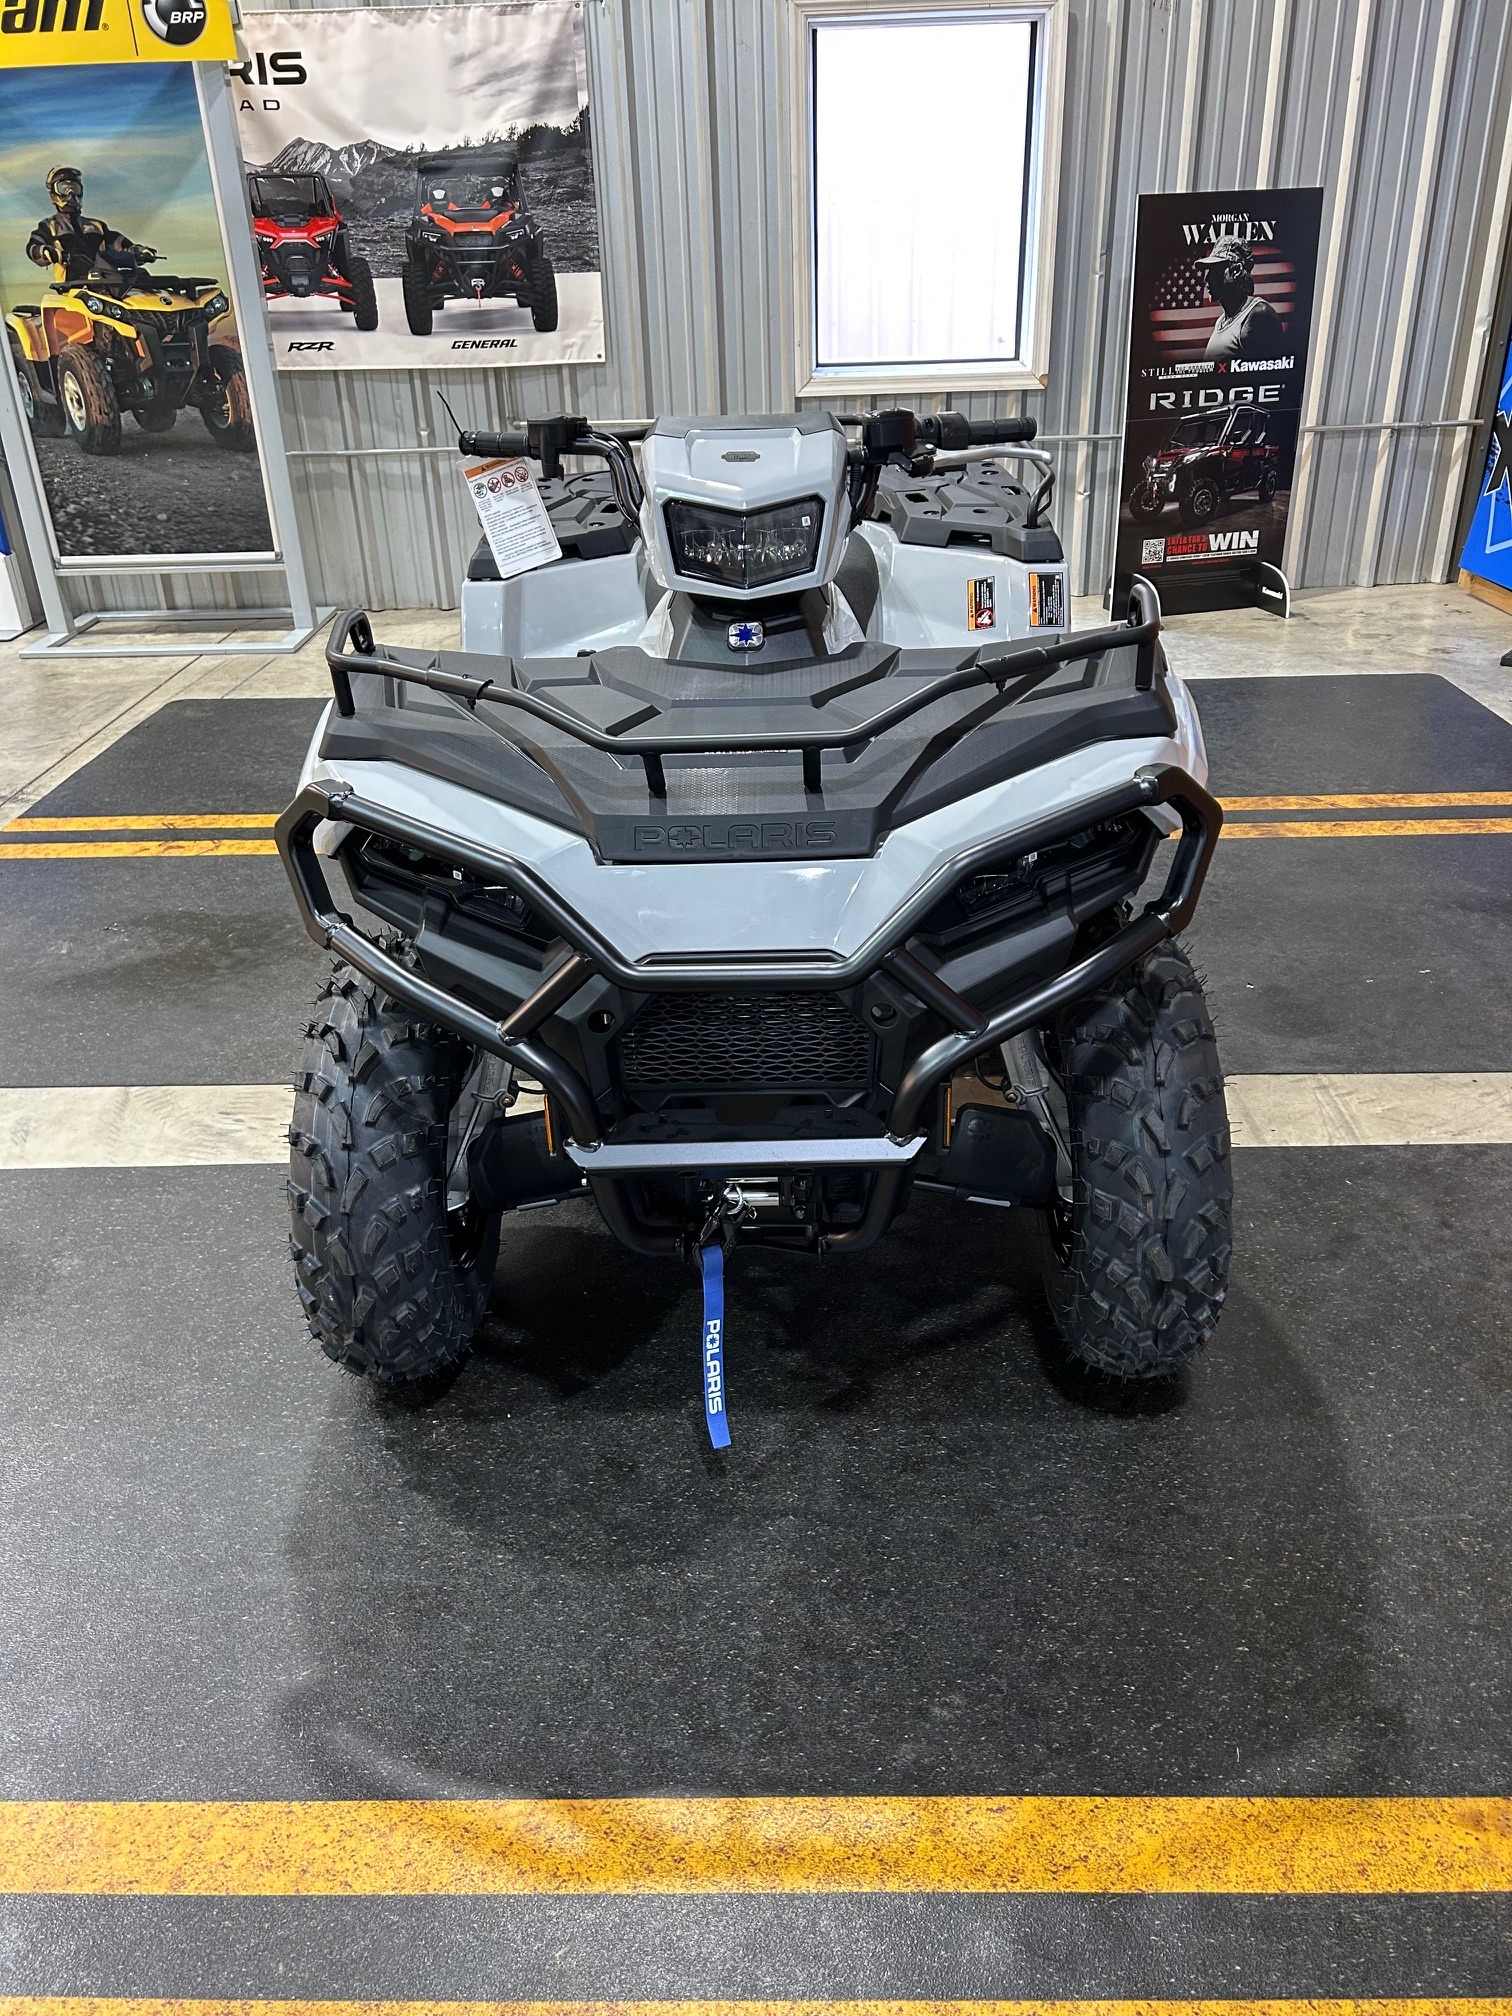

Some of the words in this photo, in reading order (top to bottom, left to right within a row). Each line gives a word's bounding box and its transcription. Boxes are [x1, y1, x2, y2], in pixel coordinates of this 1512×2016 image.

[170, 11, 205, 24] BRP
[1211, 213, 1249, 223] MORGAN
[1182, 221, 1277, 246] WALLEN
[288, 341, 335, 353] RZR
[451, 338, 518, 350] GENERAL
[1230, 355, 1295, 373] Kawasaki
[1141, 366, 1174, 378] STILL
[1150, 384, 1281, 411] RIDGE
[1167, 536, 1188, 546] ENTER
[1189, 535, 1201, 544] FOR
[1209, 530, 1260, 551] WIN
[1167, 543, 1196, 555] CHANCE
[1198, 542, 1208, 552] TO
[634, 821, 838, 851] POLARIS
[705, 1319, 723, 1415] POLARIS
